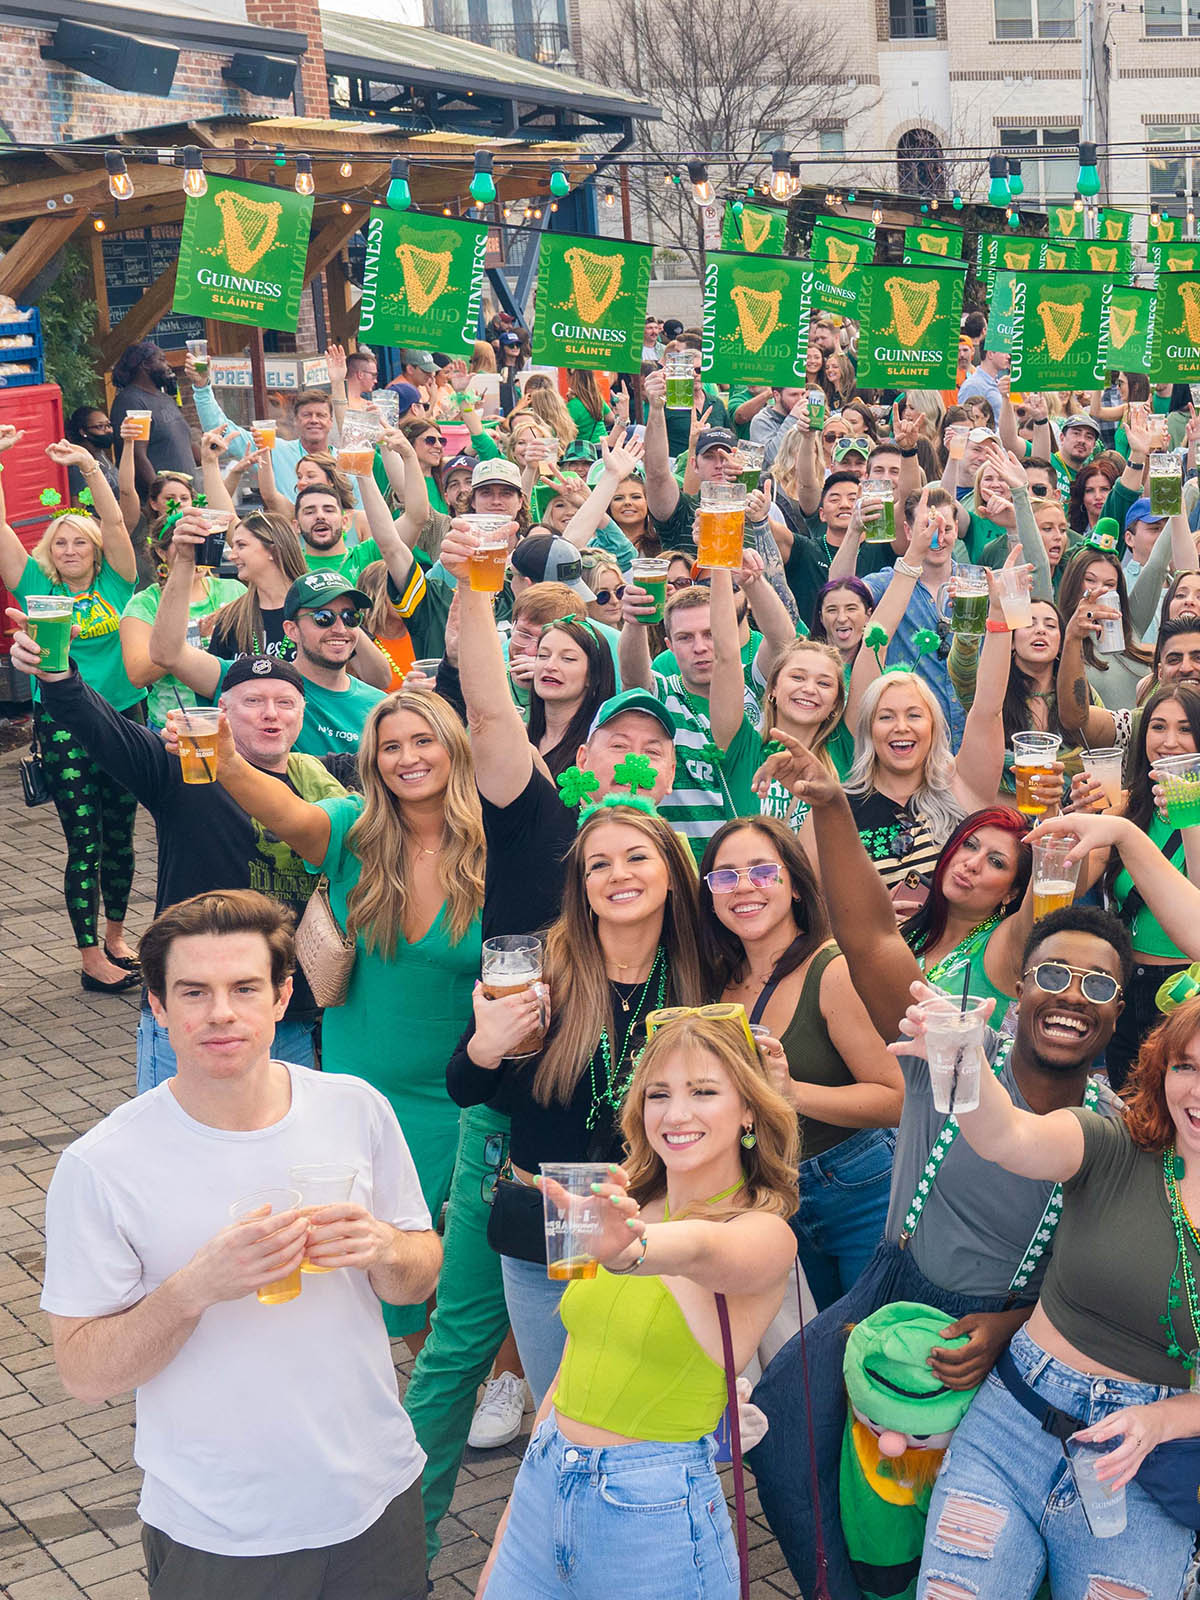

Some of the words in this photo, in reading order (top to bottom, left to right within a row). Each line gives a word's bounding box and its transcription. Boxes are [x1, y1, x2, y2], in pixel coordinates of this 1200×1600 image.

[197, 268, 282, 298] GUINNESS
[358, 217, 384, 332] GUINNESS
[211, 293, 265, 311] SLÁINTE
[461, 234, 489, 345] GUINNESS
[814, 279, 857, 301] GUINNESS
[701, 263, 719, 373] GUINNESS
[792, 271, 814, 378] GUINNESS
[551, 322, 627, 343] GUINNESS
[1010, 282, 1027, 383] GUINNESS
[1093, 283, 1114, 381] GUINNESS
[1142, 297, 1158, 368] GUINNESS
[566, 345, 612, 357] SLÁINTE
[874, 346, 943, 363] GUINNESS
[214, 370, 295, 387] PRETELS
[887, 366, 930, 377] SLÁINTE
[335, 729, 359, 743] rage
